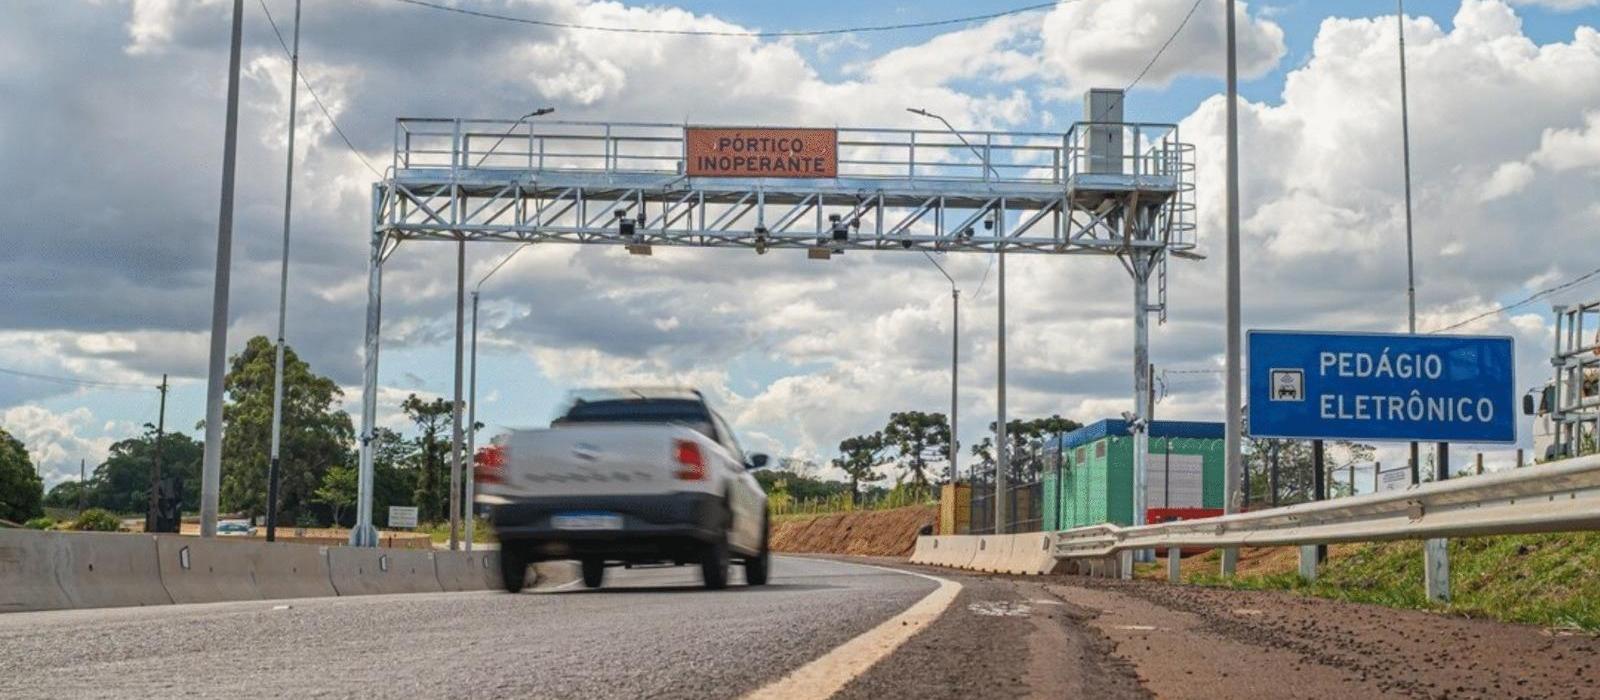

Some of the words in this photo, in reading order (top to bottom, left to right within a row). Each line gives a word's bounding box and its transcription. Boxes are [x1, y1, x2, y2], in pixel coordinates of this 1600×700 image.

[719, 133, 804, 153] PÓRTICO
[697, 156, 826, 172] INOPERANTE
[1319, 347, 1442, 380] PEDÁGIO
[1320, 389, 1494, 423] ELETRÔNICO
